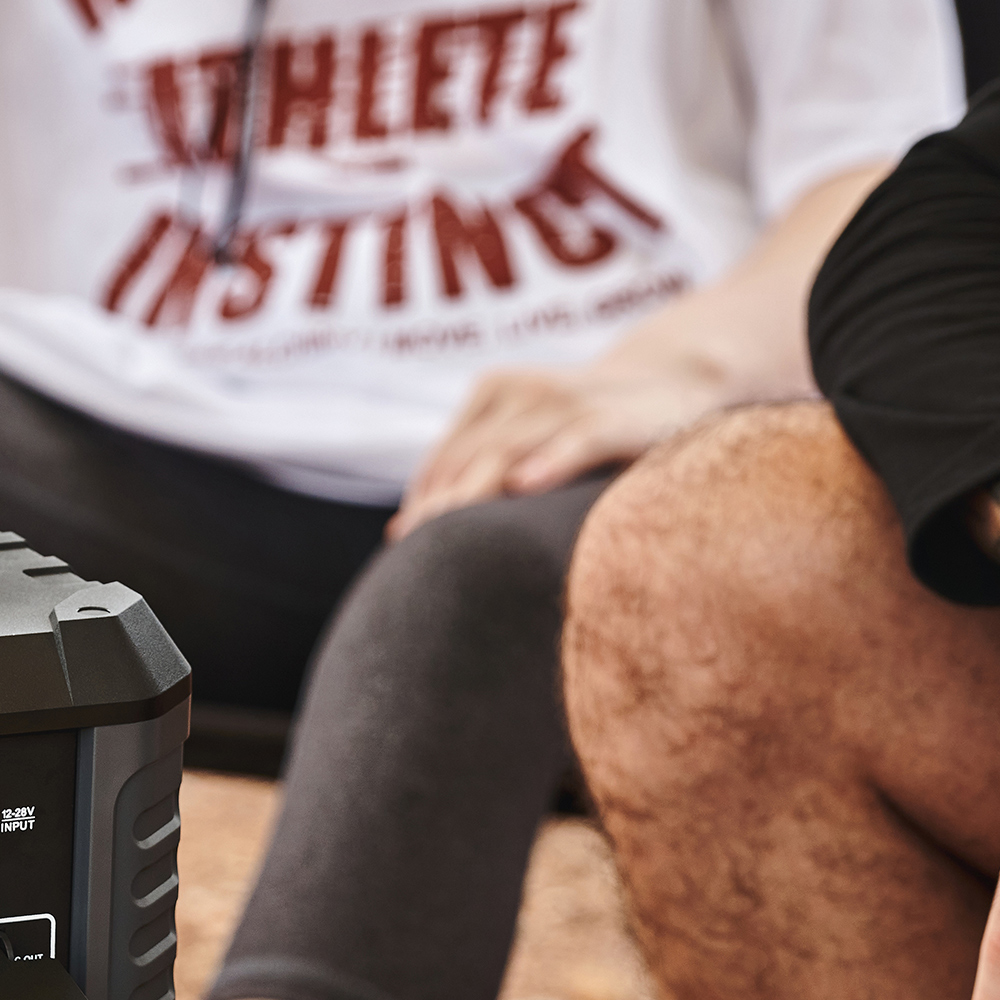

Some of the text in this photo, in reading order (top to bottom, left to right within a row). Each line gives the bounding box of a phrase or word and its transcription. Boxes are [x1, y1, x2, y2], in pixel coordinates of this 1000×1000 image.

[100, 124, 670, 330] INSTINCT
[1, 806, 36, 819] 12-28V
[0, 819, 36, 833] INPUT
